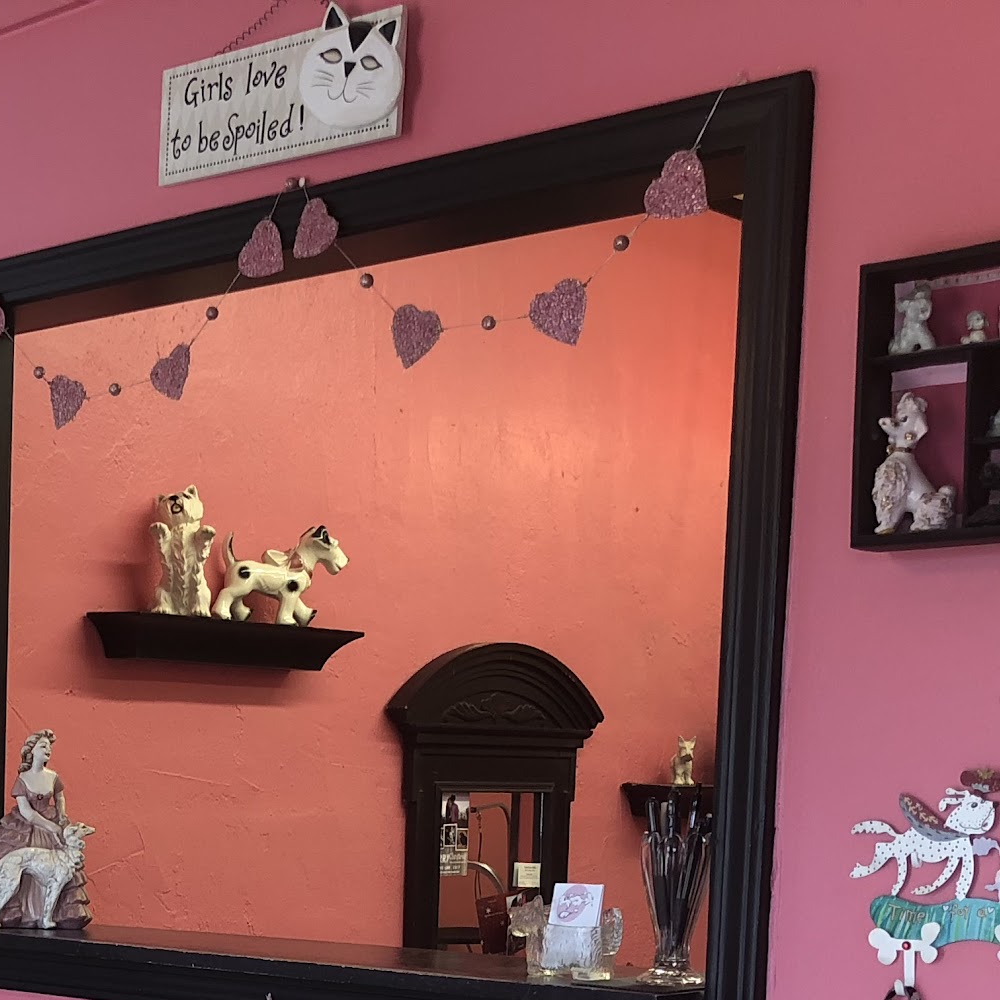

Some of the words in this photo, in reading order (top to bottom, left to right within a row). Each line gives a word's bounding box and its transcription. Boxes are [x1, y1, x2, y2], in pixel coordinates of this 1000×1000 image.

[184, 72, 233, 108] Girls
[245, 61, 287, 95] love
[171, 129, 191, 159] to
[198, 120, 221, 153] be
[889, 903, 925, 924] Time
[950, 904, 969, 921] for
[977, 908, 987, 918] a
